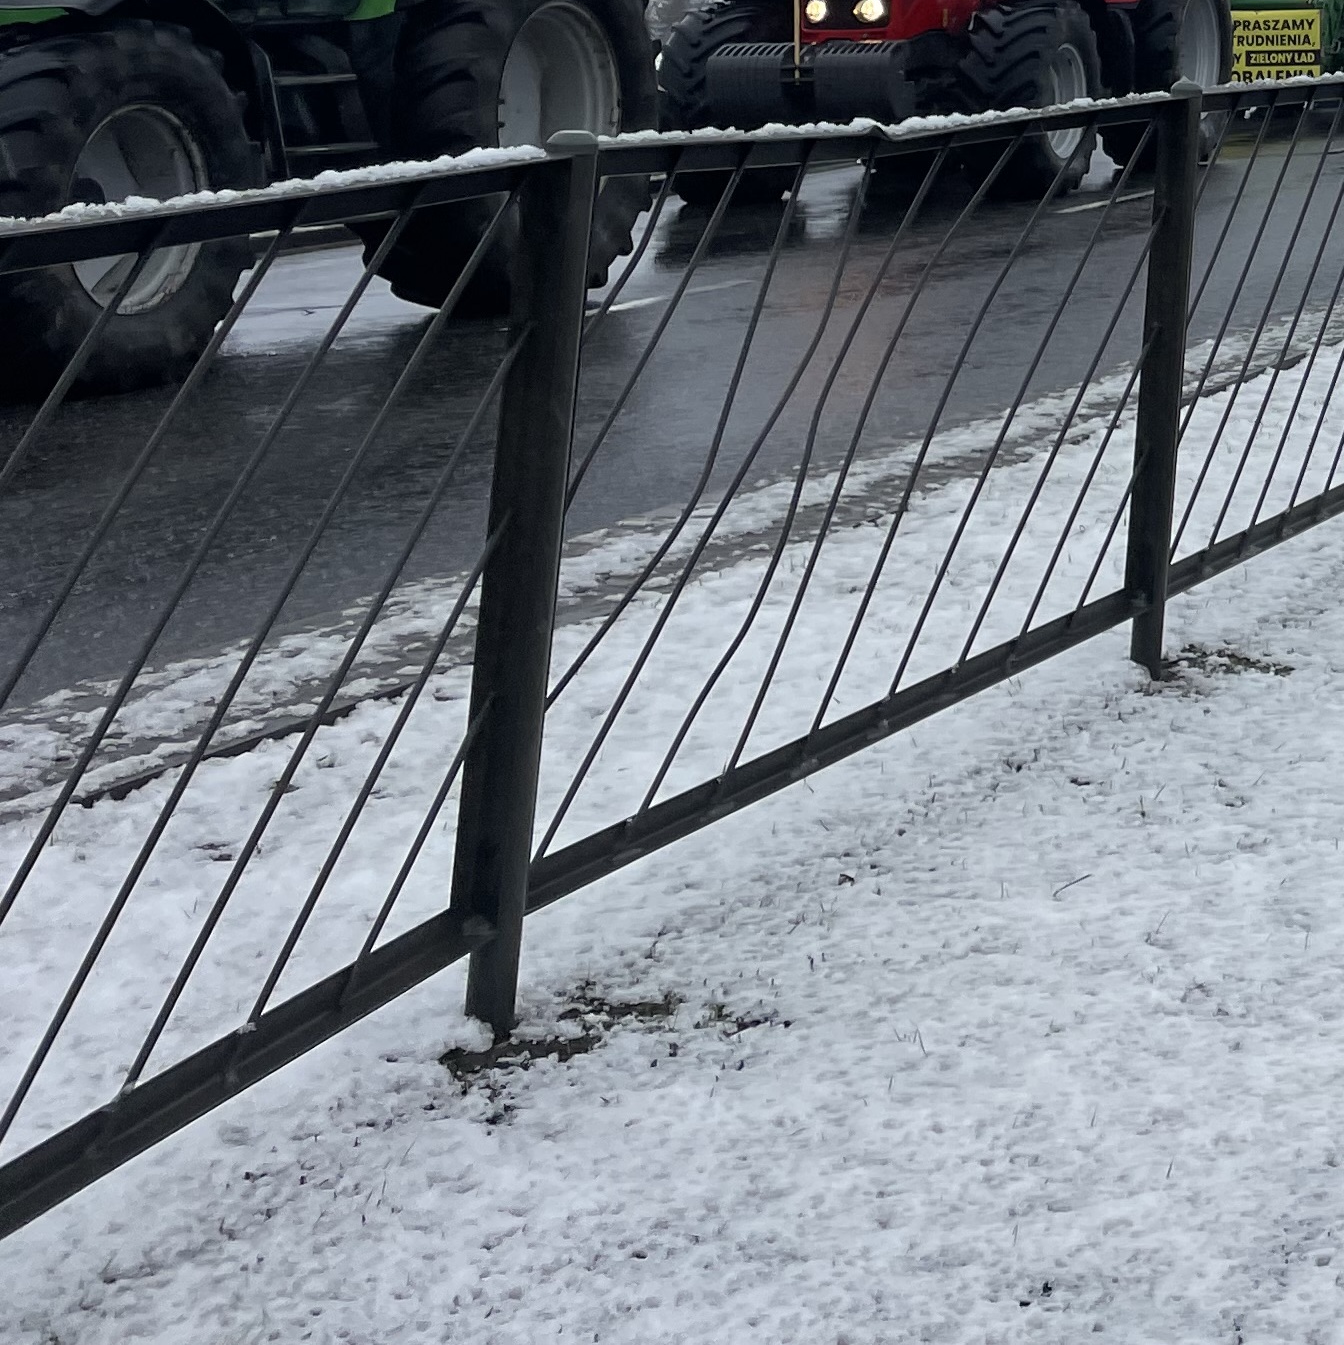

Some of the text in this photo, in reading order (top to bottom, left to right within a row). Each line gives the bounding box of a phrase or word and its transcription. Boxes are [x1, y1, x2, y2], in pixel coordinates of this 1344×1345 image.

[1233, 18, 1315, 31] PRASZAMY
[1233, 34, 1316, 48] RUDNIENIA,
[1249, 52, 1293, 64] ZIELONY
